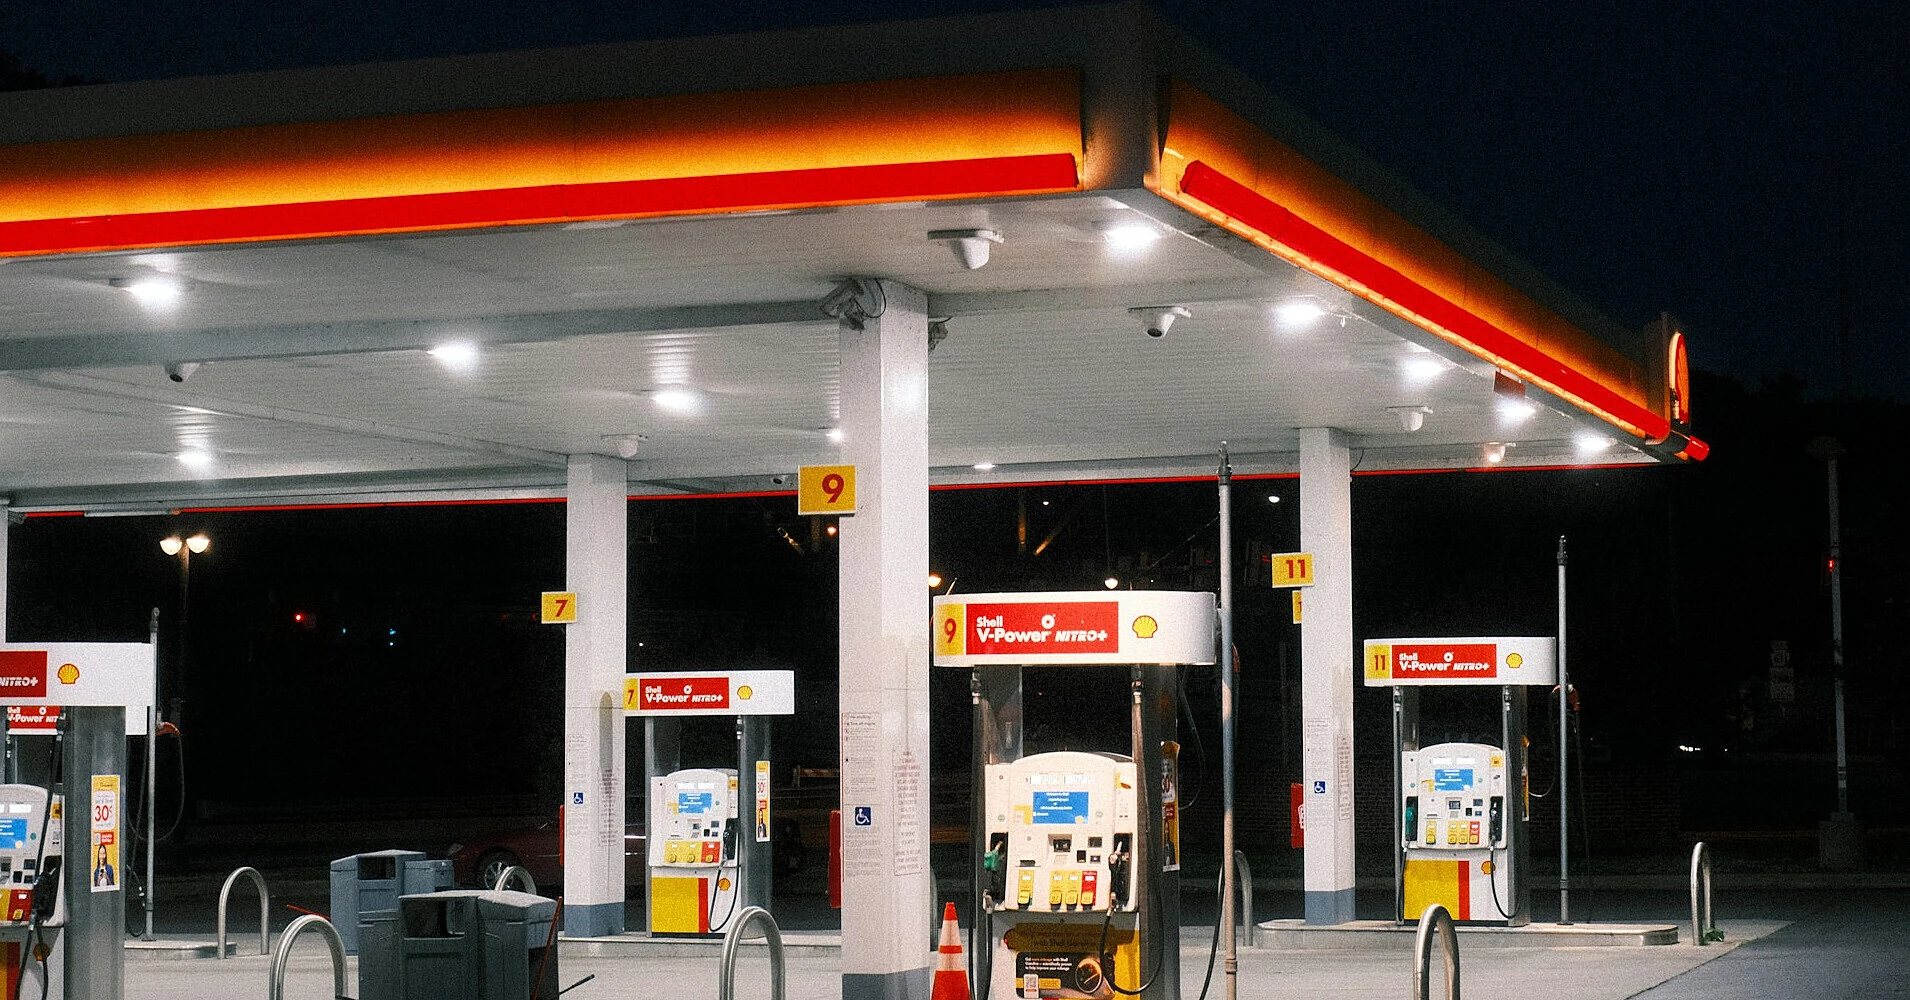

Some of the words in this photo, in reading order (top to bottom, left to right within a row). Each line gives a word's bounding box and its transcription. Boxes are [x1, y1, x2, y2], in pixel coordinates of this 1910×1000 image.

[822, 474, 844, 503] 9
[1286, 559, 1306, 578] 11
[555, 600, 568, 617] 7
[976, 615, 1003, 628] Shell
[944, 618, 957, 643] 9
[976, 628, 1051, 643] V-Power
[1054, 630, 1108, 642] NITRO+
[1375, 655, 1385, 670] 11
[1399, 653, 1418, 661] Shell
[1399, 661, 1451, 671] V-Power
[1453, 663, 1490, 671] NITRO+
[628, 689, 635, 705] 7
[645, 686, 661, 694] Shell
[645, 693, 689, 703] V-Power
[691, 694, 723, 702] NITRO+
